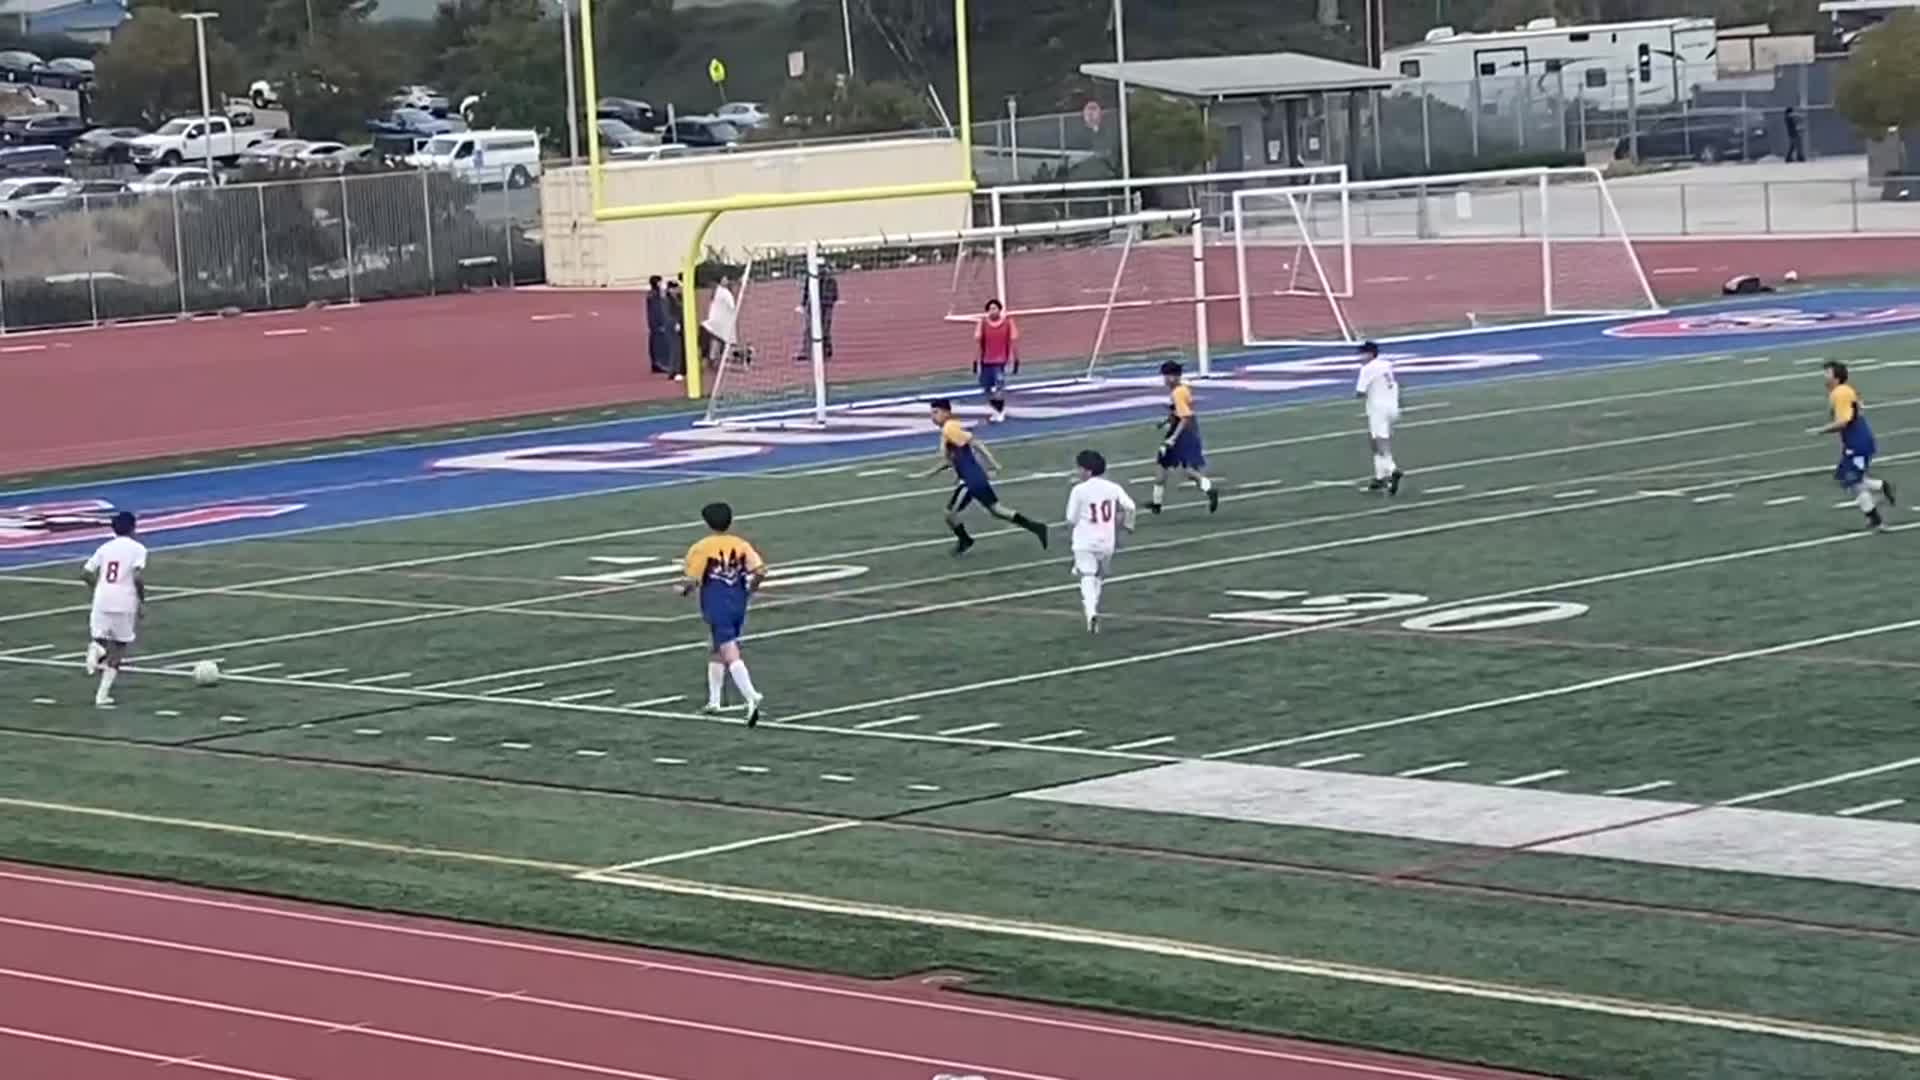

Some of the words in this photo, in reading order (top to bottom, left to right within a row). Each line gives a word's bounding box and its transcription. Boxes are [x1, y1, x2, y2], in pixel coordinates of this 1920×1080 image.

[1089, 500, 1112, 524] 10
[106, 560, 120, 584] 8
[1208, 591, 1590, 632] 20
